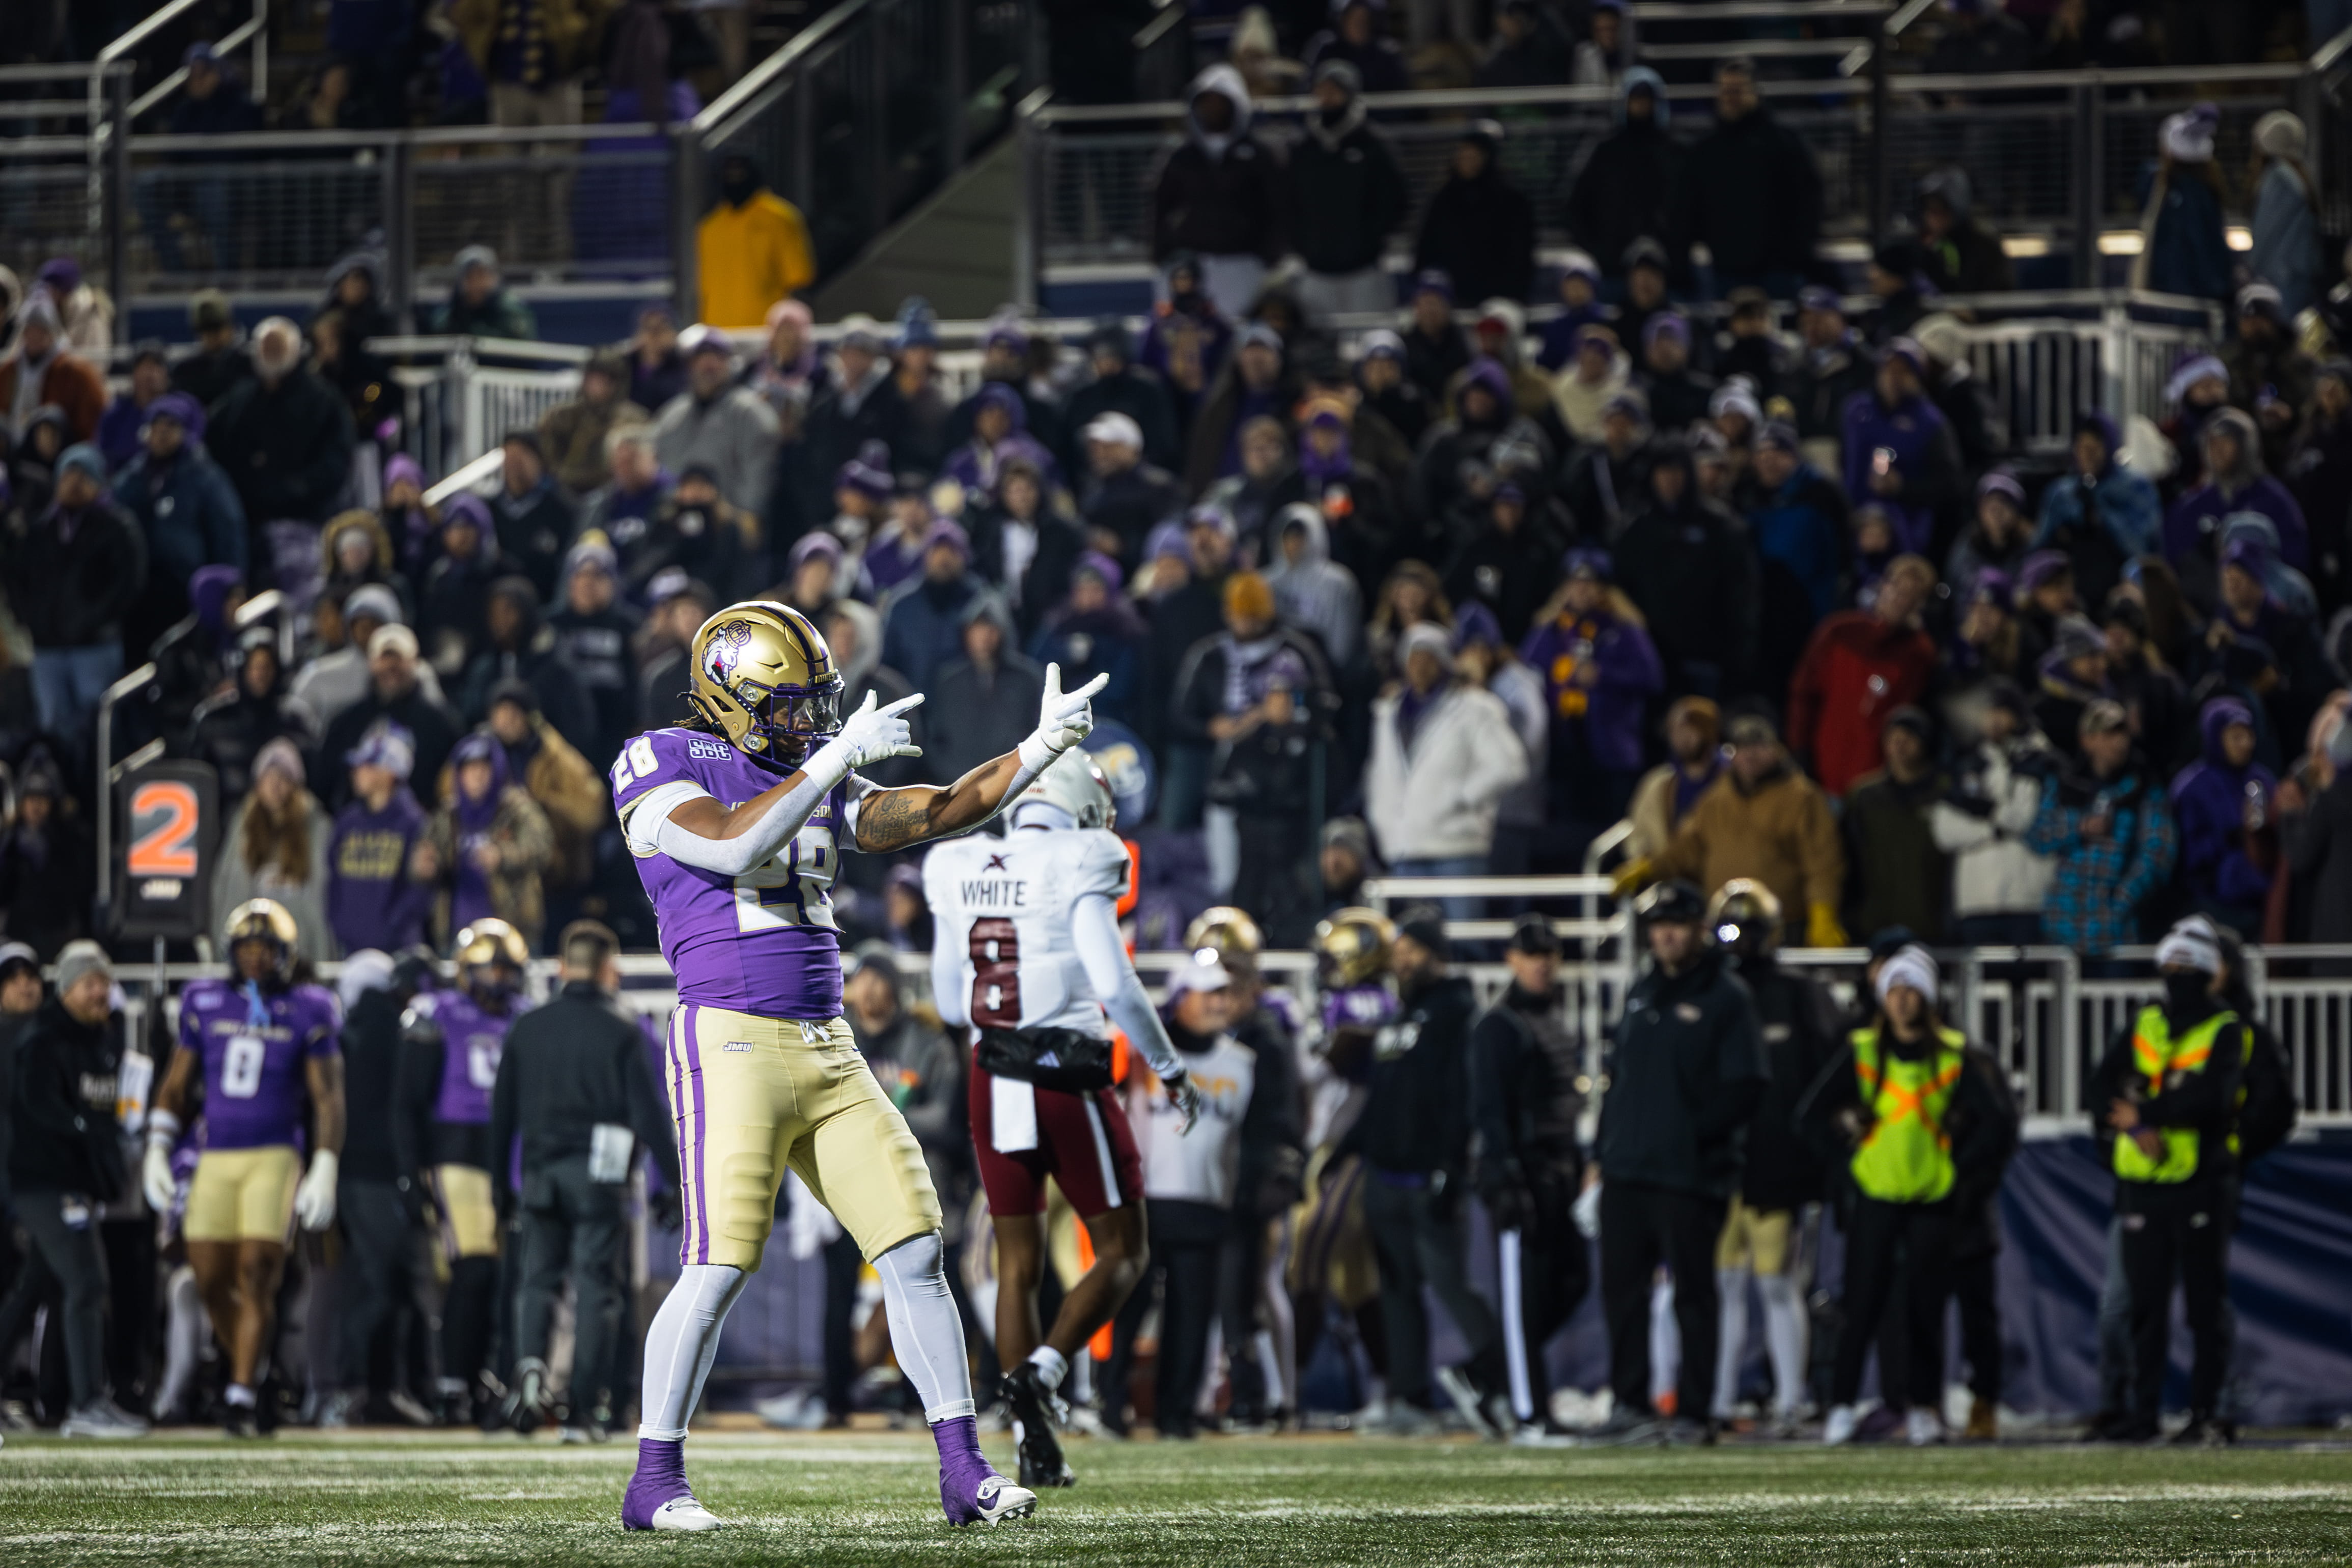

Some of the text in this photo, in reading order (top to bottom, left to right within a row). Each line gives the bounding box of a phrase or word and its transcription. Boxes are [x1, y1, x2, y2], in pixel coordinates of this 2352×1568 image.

[614, 736, 659, 795] 28
[687, 738, 733, 761] SBC
[129, 780, 199, 877] 2
[734, 826, 840, 933] 28
[961, 881, 1028, 906] WHITE
[969, 916, 1022, 1029] 8
[723, 1042, 752, 1052] JMU
